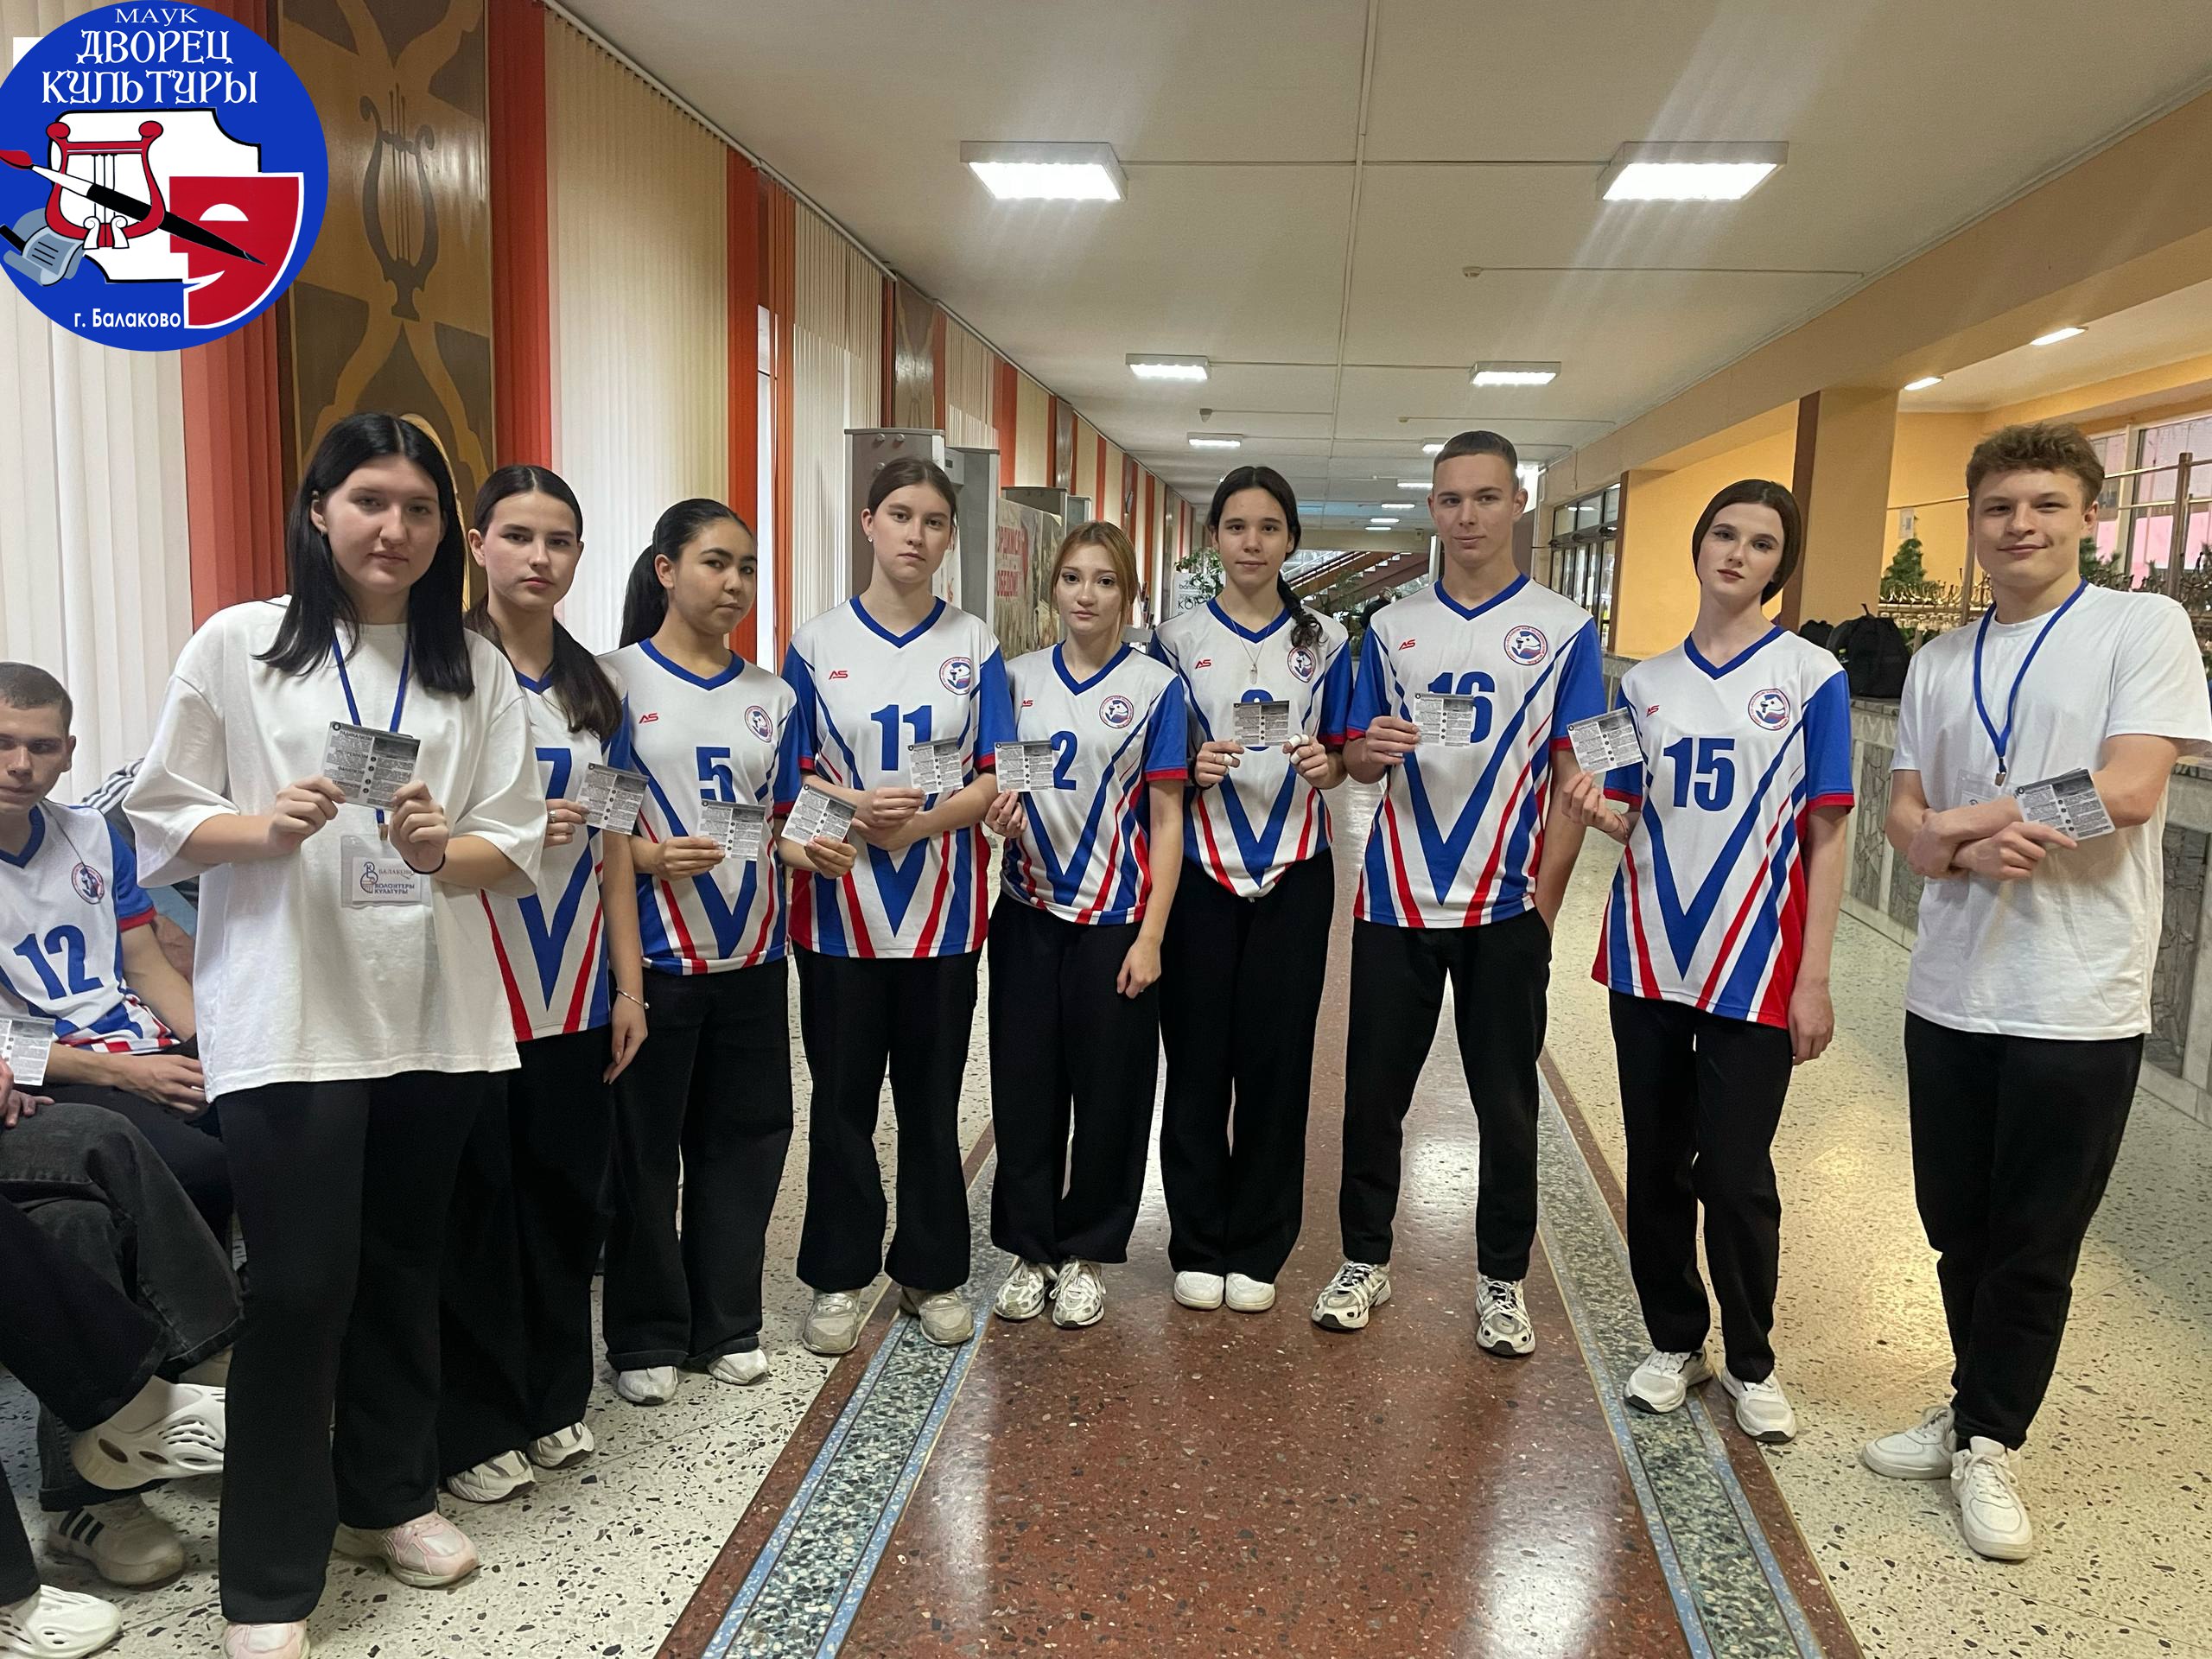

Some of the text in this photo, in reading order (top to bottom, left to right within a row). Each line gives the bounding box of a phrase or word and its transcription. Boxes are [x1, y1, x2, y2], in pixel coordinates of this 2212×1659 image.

[1195, 659, 1211, 669] AS
[1399, 639, 1416, 651] AS
[829, 671, 849, 680] AS
[639, 713, 659, 724] AS
[871, 704, 932, 771] 11
[535, 747, 573, 800] 7
[696, 747, 736, 803] 5
[1051, 730, 1077, 791] 2
[1663, 737, 1736, 811] 15
[13, 925, 104, 1000] 12
